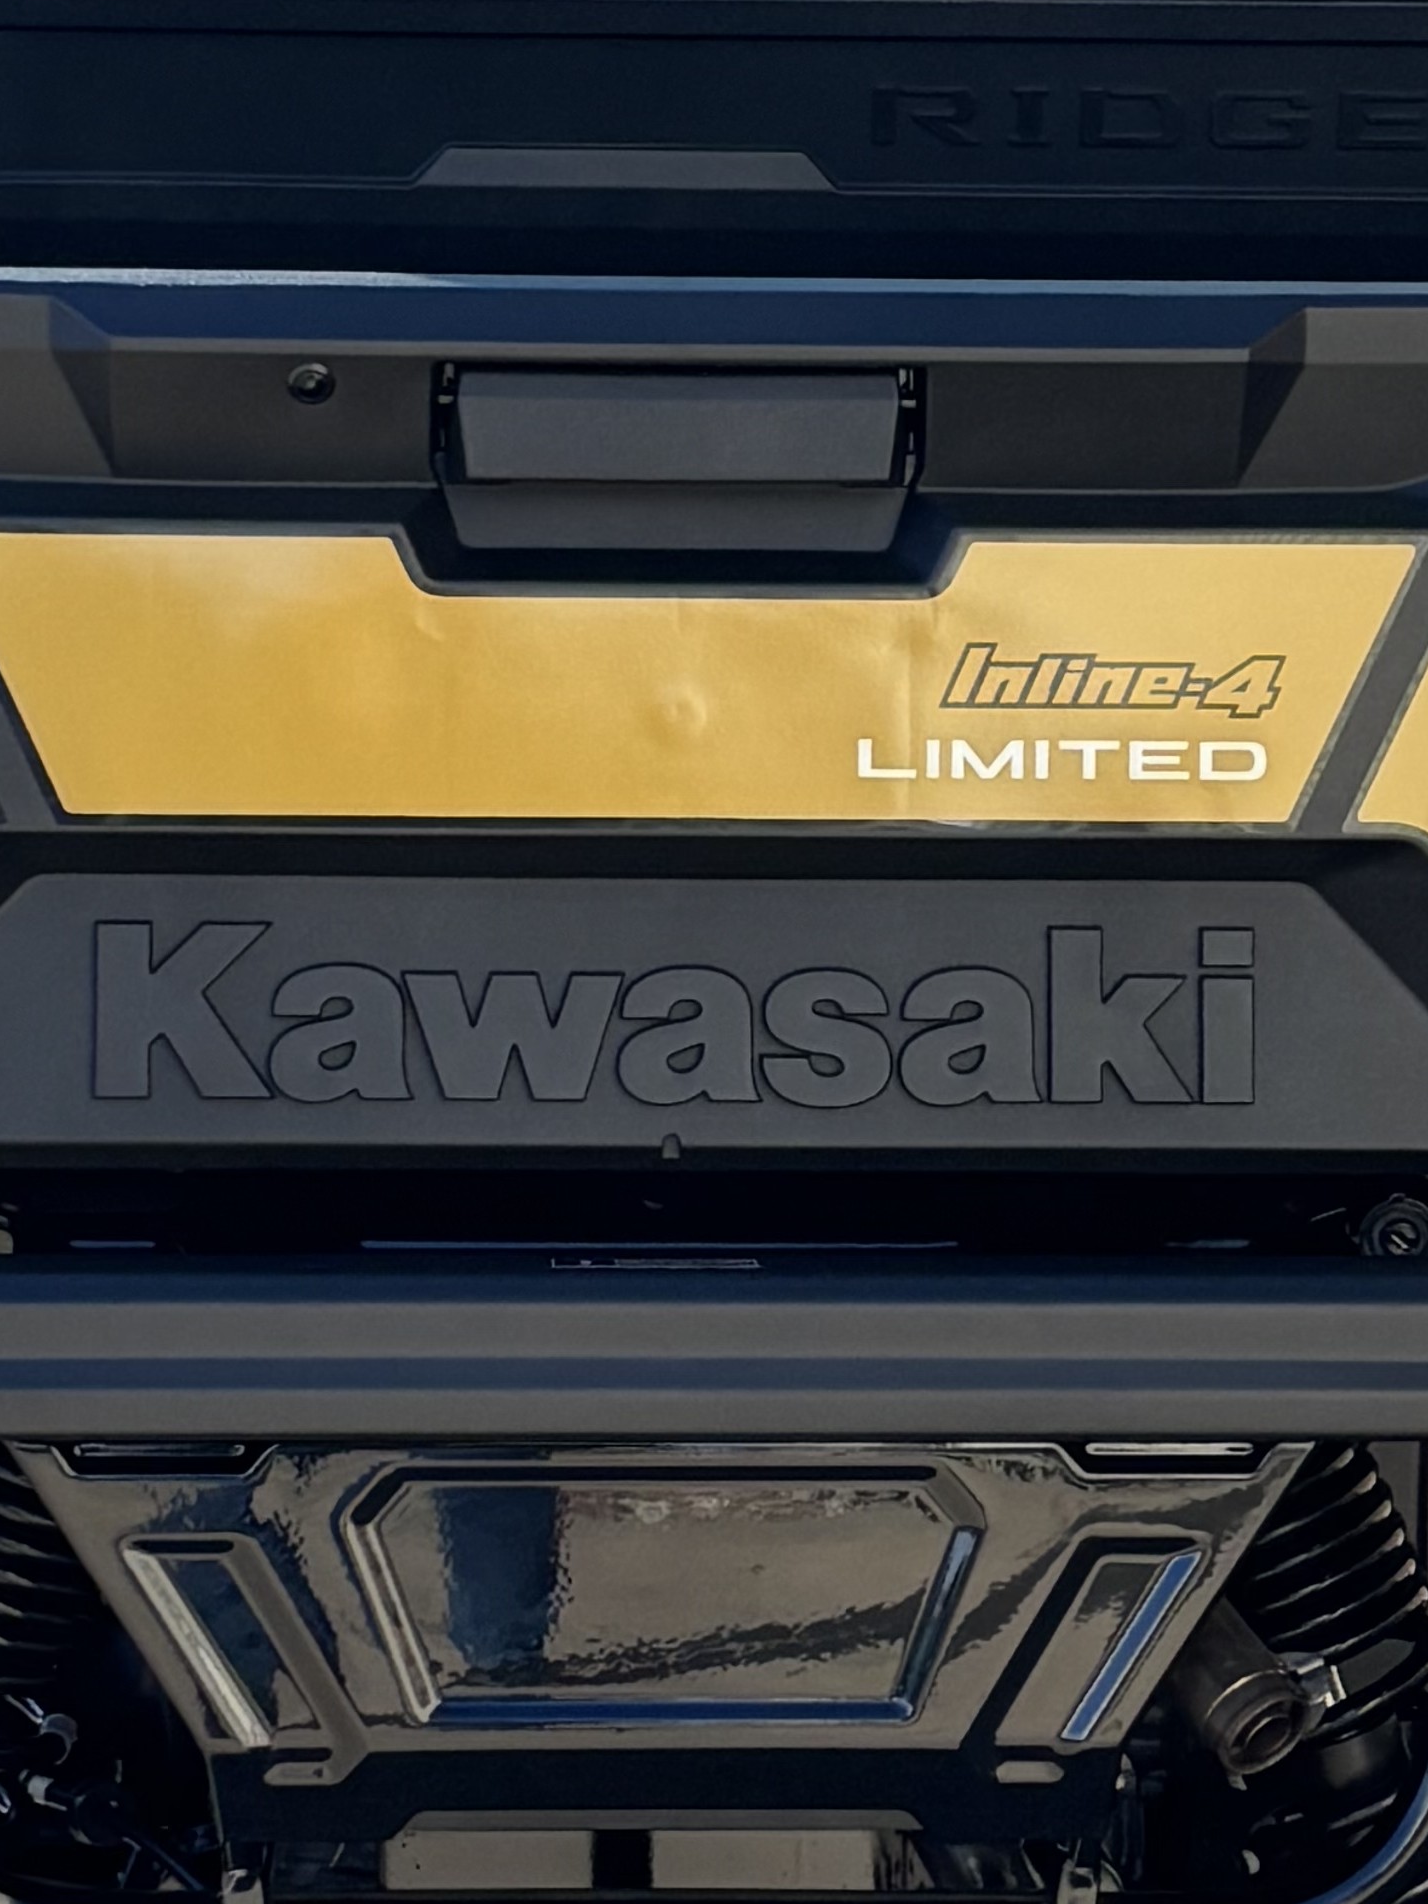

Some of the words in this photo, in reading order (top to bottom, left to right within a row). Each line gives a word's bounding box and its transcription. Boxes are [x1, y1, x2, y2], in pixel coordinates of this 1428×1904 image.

[939, 642, 1286, 719] Inline-4
[857, 738, 1267, 781] LIMITED
[93, 920, 1255, 1108] Kawasaki
